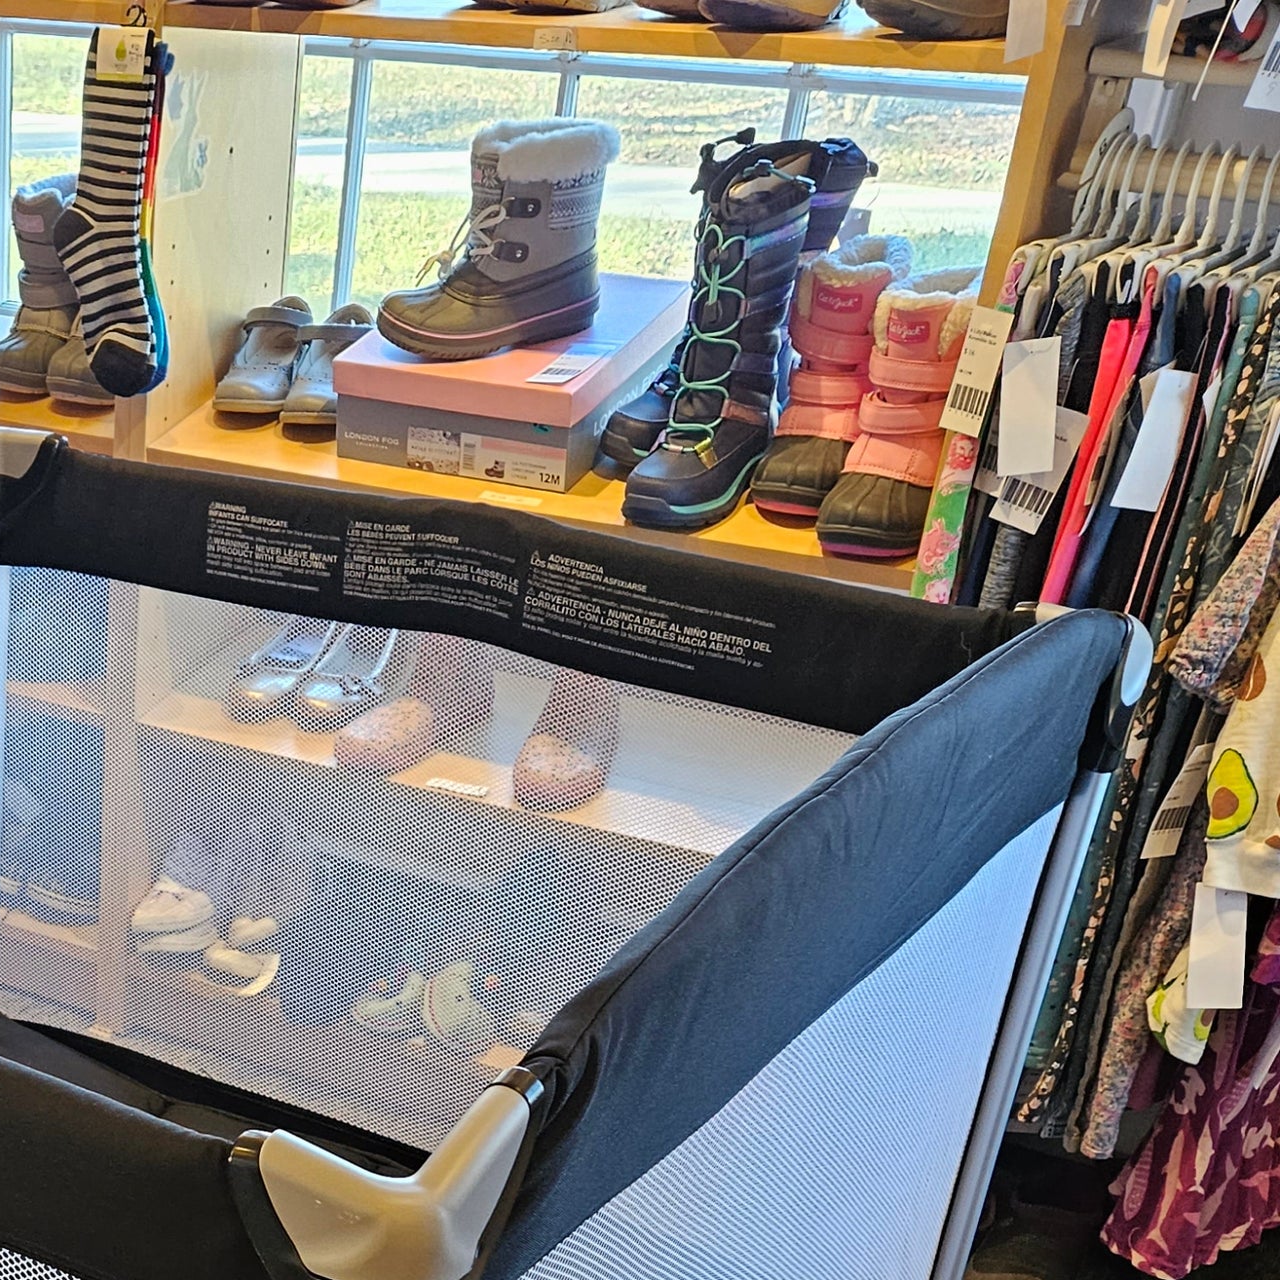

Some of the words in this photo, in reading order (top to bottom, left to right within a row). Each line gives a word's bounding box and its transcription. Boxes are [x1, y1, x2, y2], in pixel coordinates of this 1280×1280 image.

[344, 431, 379, 442] LONDON
[382, 437, 399, 445] FOG
[539, 472, 560, 485] 12M
[215, 503, 246, 514] WARNING
[208, 510, 235, 519] INFANTS
[236, 514, 250, 522] CAN
[251, 516, 288, 528] SUFFOCATE
[355, 521, 371, 530] MISE
[385, 524, 410, 533] GARDE
[385, 532, 415, 541] PEUVENT
[417, 533, 459, 544] SUFFOQUER
[207, 544, 215, 552] IN
[217, 546, 253, 558] PRODUCT
[255, 552, 274, 563] WITH
[276, 555, 298, 566] SIDES
[301, 559, 327, 569] DOWN.
[213, 537, 249, 550] WARNING
[255, 544, 281, 555] NEVER
[284, 549, 307, 559] LEAVE
[310, 552, 338, 563] INFANT
[353, 555, 373, 564] MISE
[388, 558, 417, 566] GARDE
[437, 561, 468, 573] JAMAIS
[470, 566, 507, 582] LAISSER
[509, 576, 519, 587] LE
[548, 554, 604, 574] ADVERTENCIA
[344, 571, 366, 579] SONT
[368, 565, 390, 573] DANS
[404, 567, 426, 576] PARC
[430, 568, 469, 581] LORSQUE
[472, 576, 488, 586] LES
[531, 558, 546, 568] LOS
[571, 567, 602, 582] PUEDEN
[603, 577, 647, 593] ASFIXIARSE
[524, 596, 576, 617] CORRALITO
[578, 611, 598, 623] CON
[601, 617, 619, 628] LOS
[621, 621, 676, 641] LATERALES
[677, 635, 707, 648] HACIA
[708, 642, 746, 657] ABAJO.
[538, 591, 601, 614] ADVERTENCIA
[608, 609, 641, 623] NUNCA
[642, 617, 667, 630] DEJE
[669, 623, 681, 634] AL
[684, 626, 708, 638] NIÑO
[709, 632, 751, 647] DENTRO
[752, 641, 772, 653] DEL
